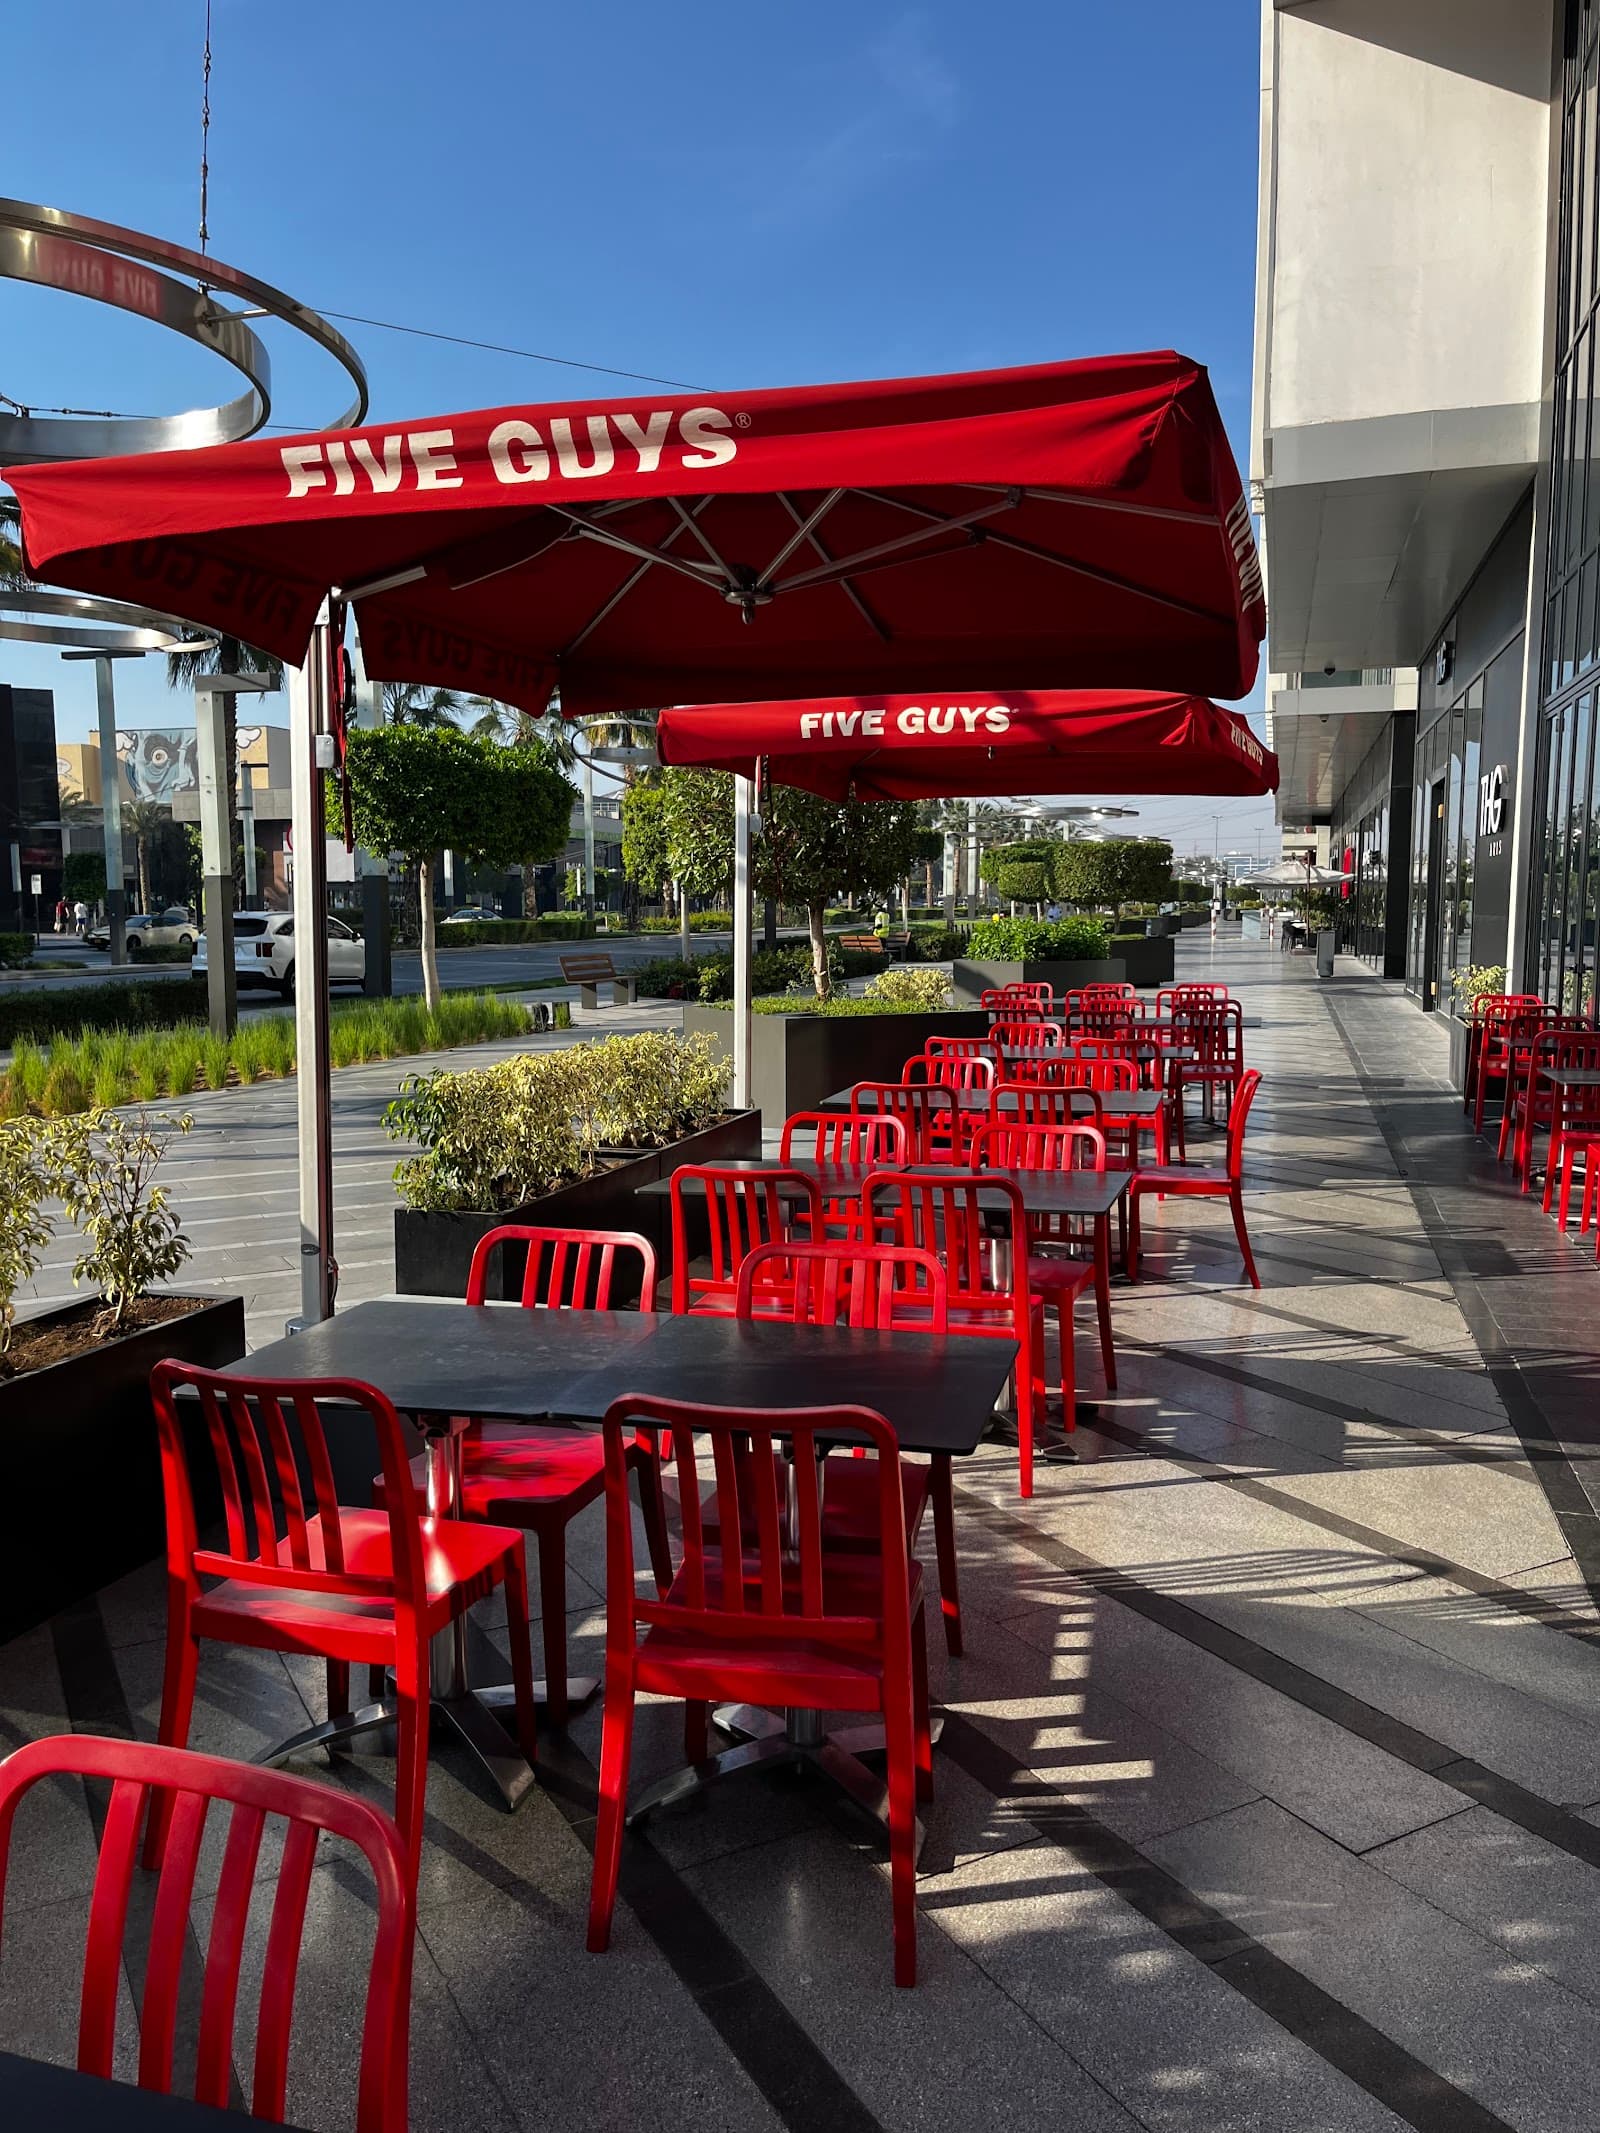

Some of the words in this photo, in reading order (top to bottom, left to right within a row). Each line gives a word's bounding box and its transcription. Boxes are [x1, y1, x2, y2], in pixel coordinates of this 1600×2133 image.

[280, 429, 464, 499] FIVE
[800, 709, 886, 737] FIVE
[896, 707, 1010, 734] GUYS
